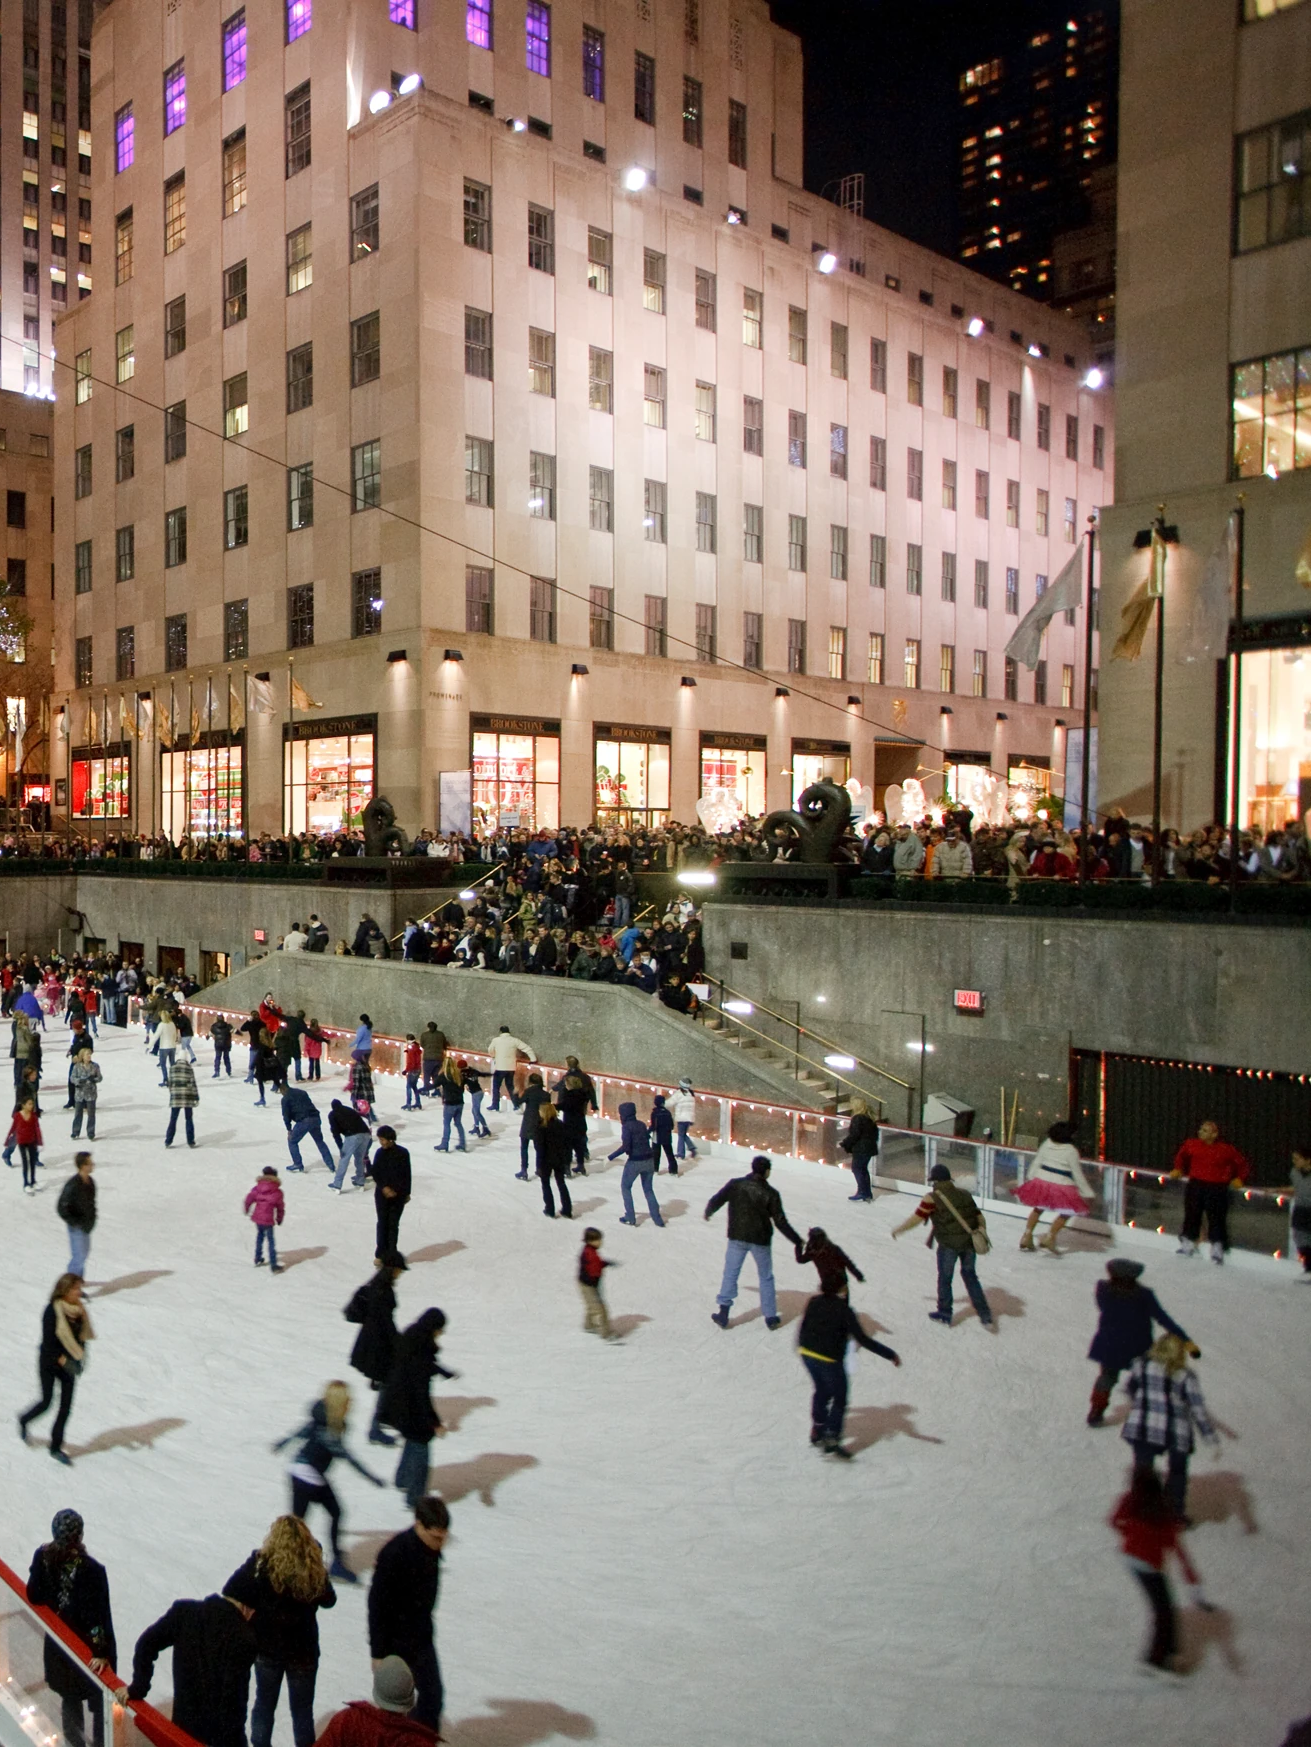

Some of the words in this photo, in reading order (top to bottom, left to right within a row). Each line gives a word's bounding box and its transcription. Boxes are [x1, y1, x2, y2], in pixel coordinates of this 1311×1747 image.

[298, 721, 358, 735] BROOKSTONE
[490, 718, 545, 731] BROOKSTONE
[611, 727, 658, 739] BROOKSTONE
[957, 991, 978, 1006] EXIT
